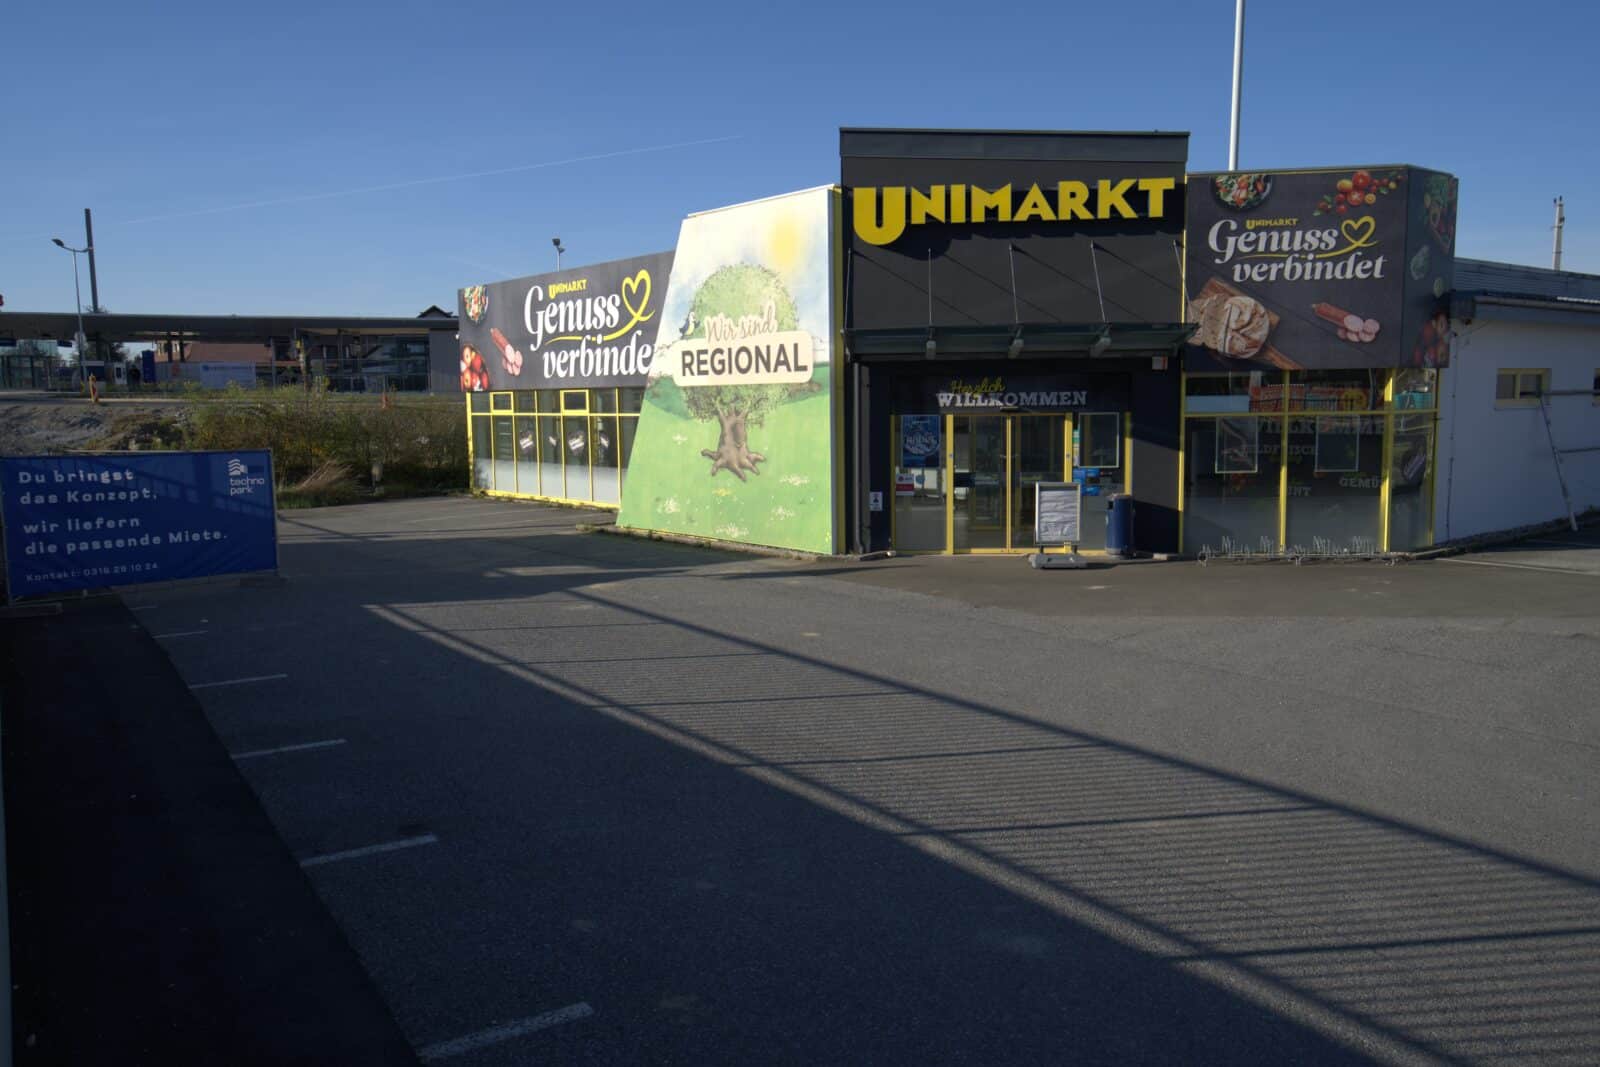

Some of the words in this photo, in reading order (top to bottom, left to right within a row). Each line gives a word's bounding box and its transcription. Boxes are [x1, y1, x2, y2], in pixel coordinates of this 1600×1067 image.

[853, 177, 1175, 245] UNIMARKT
[1245, 218, 1298, 229] UNIMARKT
[1208, 219, 1338, 264] Genuss
[1232, 252, 1388, 282] verbindet
[548, 278, 588, 299] UNIMARKT
[524, 285, 621, 351] Genuss
[706, 314, 737, 343] Wir
[740, 302, 777, 339] sind
[681, 343, 808, 377] REGIONAL
[936, 391, 1087, 407] WILLKOMMEN
[18, 471, 46, 484] Du
[54, 469, 134, 484] bringst
[229, 475, 265, 486] techno
[20, 491, 58, 505] das
[229, 485, 254, 496] park
[23, 522, 60, 534] wir
[67, 516, 141, 531] liefern
[25, 541, 58, 555] die
[66, 534, 162, 554] passende
[168, 530, 228, 544] Miete.
